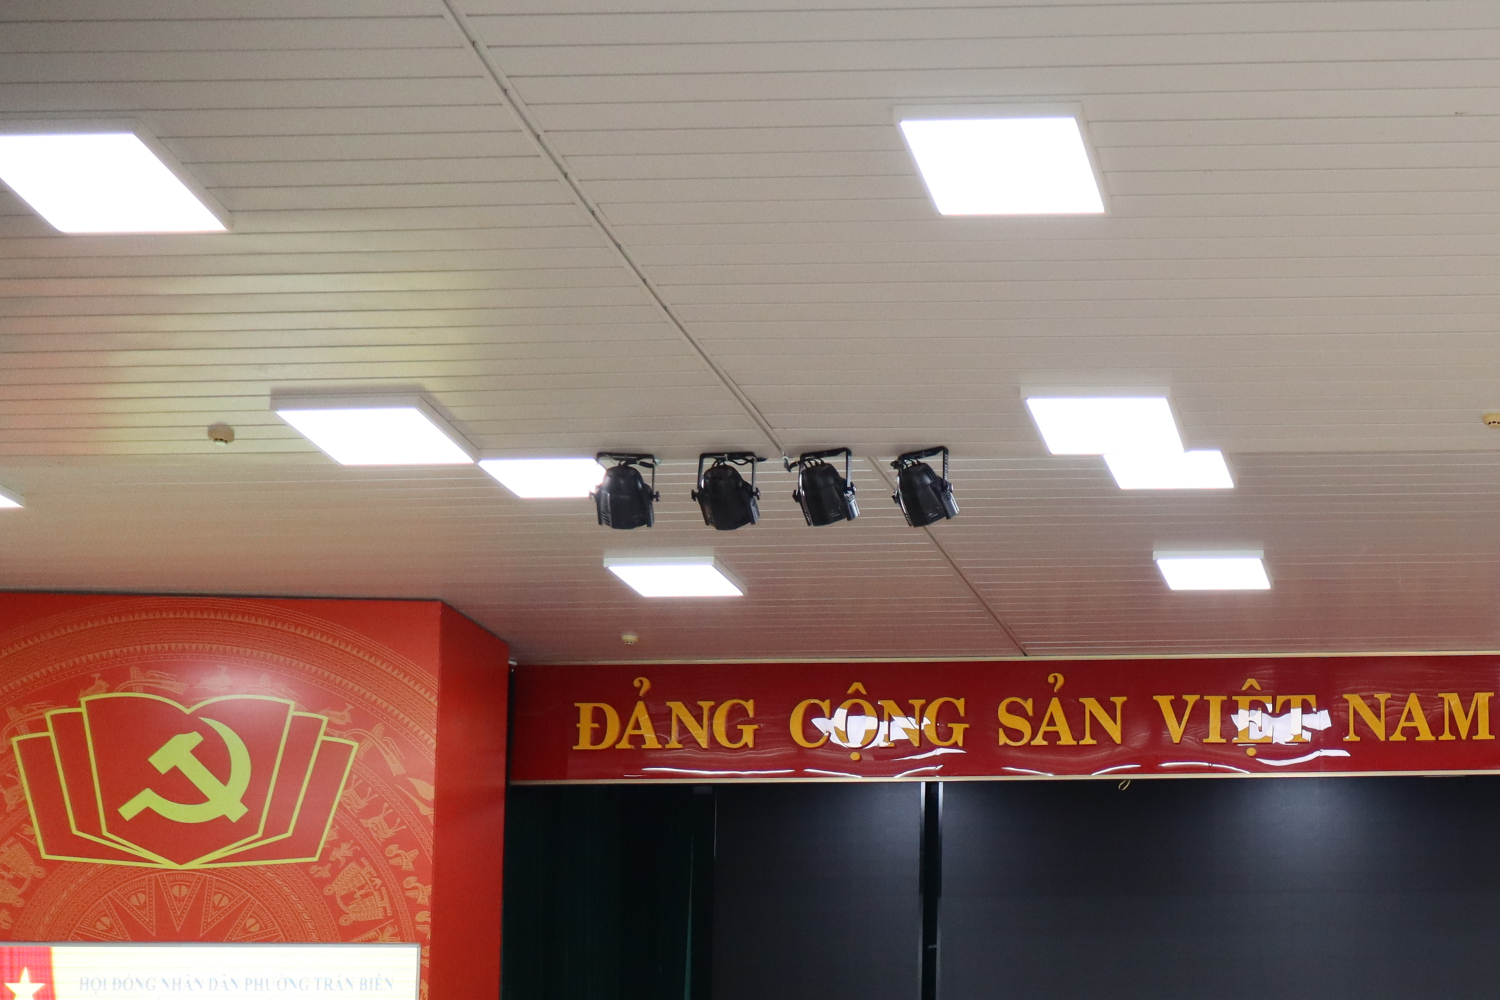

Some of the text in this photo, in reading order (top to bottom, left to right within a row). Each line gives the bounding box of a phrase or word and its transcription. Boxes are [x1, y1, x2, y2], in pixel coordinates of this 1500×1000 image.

[572, 676, 760, 751] ĐẢNG
[789, 682, 970, 761] CỘNG
[997, 672, 1127, 747] SẢN
[1153, 678, 1318, 757] VIỆT
[1343, 691, 1496, 742] NAM
